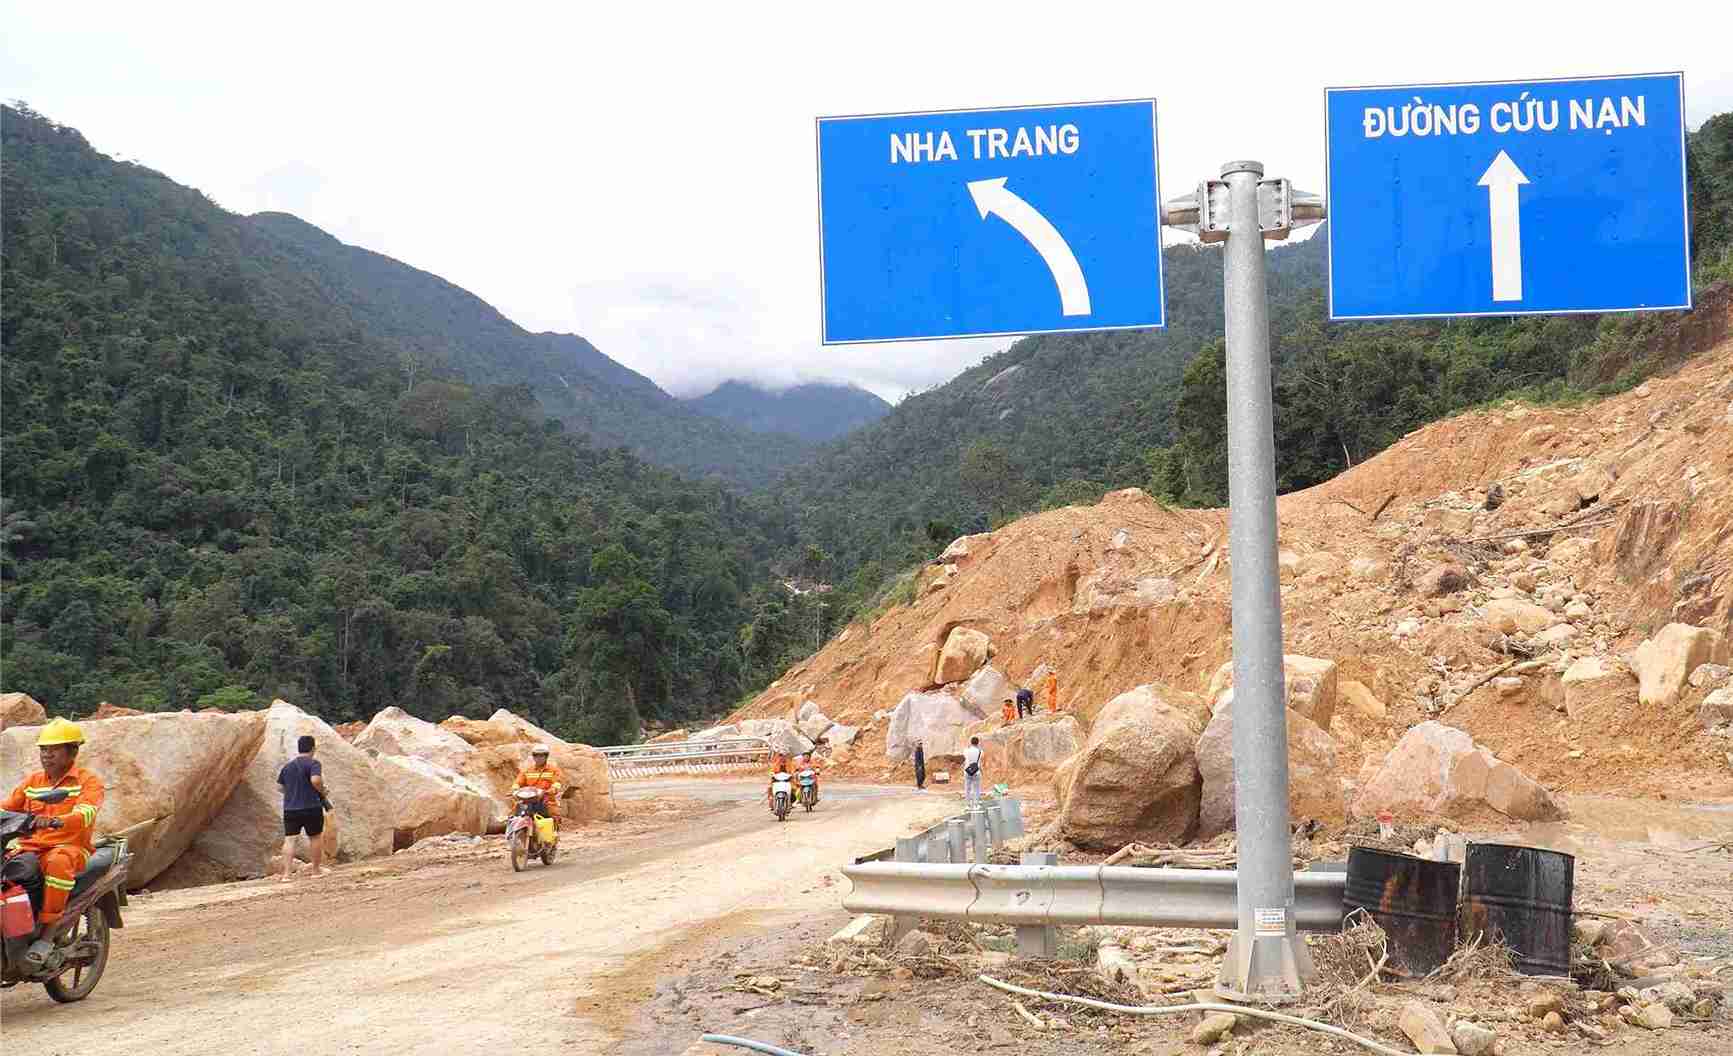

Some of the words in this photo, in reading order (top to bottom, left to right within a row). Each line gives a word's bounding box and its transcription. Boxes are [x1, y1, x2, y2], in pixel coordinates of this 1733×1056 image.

[1362, 97, 1481, 138] ĐƯỜNG
[1490, 92, 1559, 134] CỨU
[1569, 95, 1646, 135] NẠN
[890, 131, 958, 164] NHA
[966, 124, 1080, 160] TRANG
